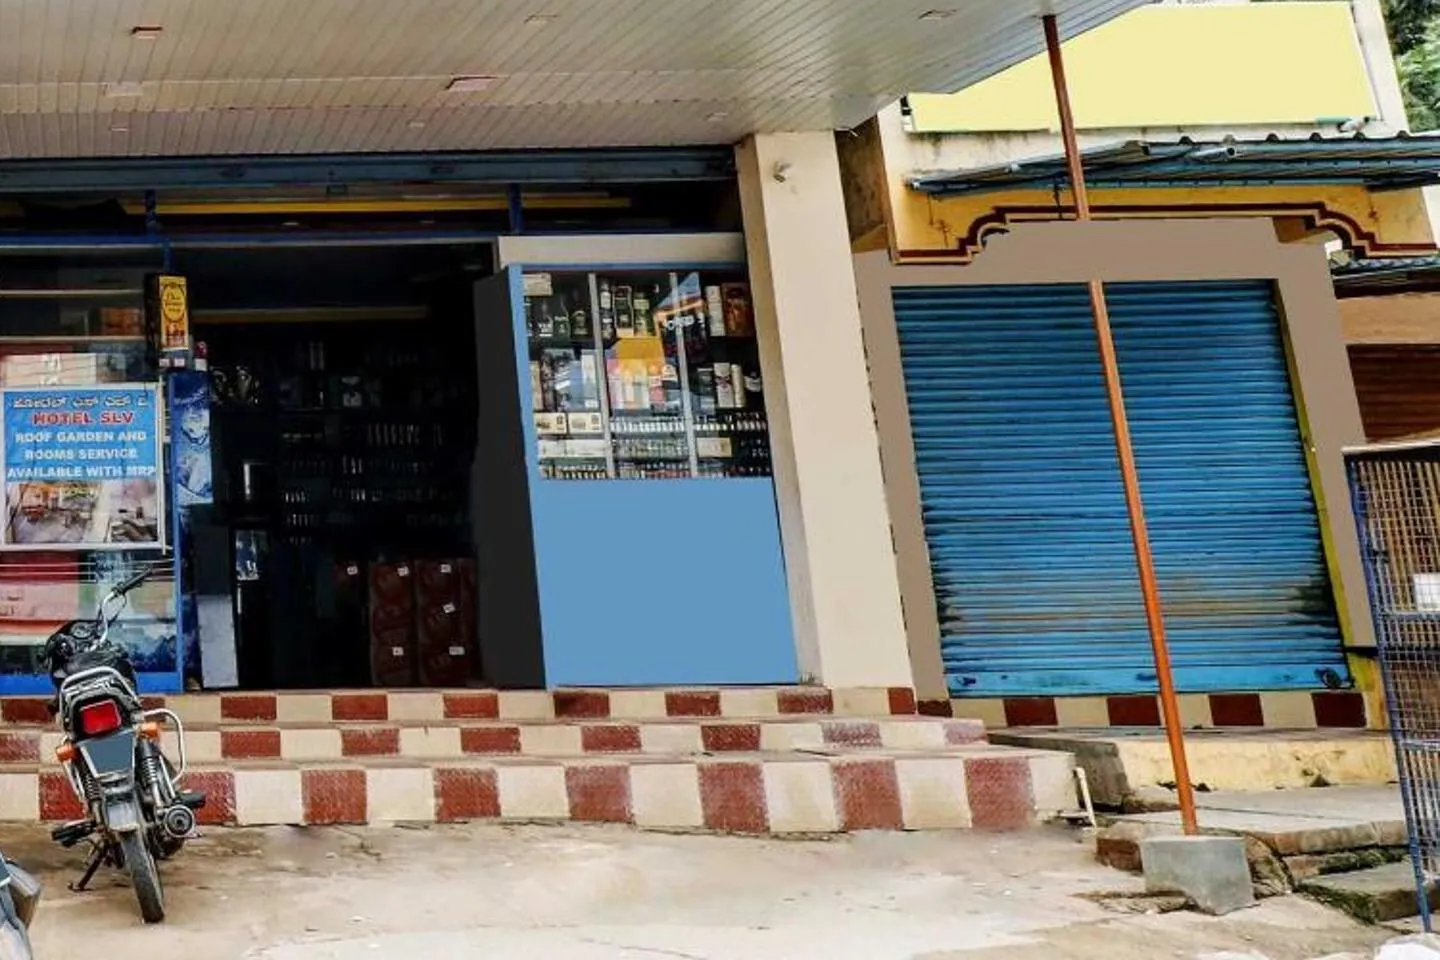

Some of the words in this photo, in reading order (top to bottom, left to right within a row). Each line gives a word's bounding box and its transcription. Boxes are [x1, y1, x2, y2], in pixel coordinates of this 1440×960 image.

[32, 411, 93, 426] HOTEL
[100, 411, 134, 424] SLV
[15, 431, 53, 443] ROOF
[57, 431, 114, 442] GARDEN
[117, 430, 147, 441] AND
[25, 449, 75, 461] ROOMS
[78, 447, 138, 460] SERVICE
[7, 466, 83, 478] AVAILABLE
[86, 465, 123, 477] WITH
